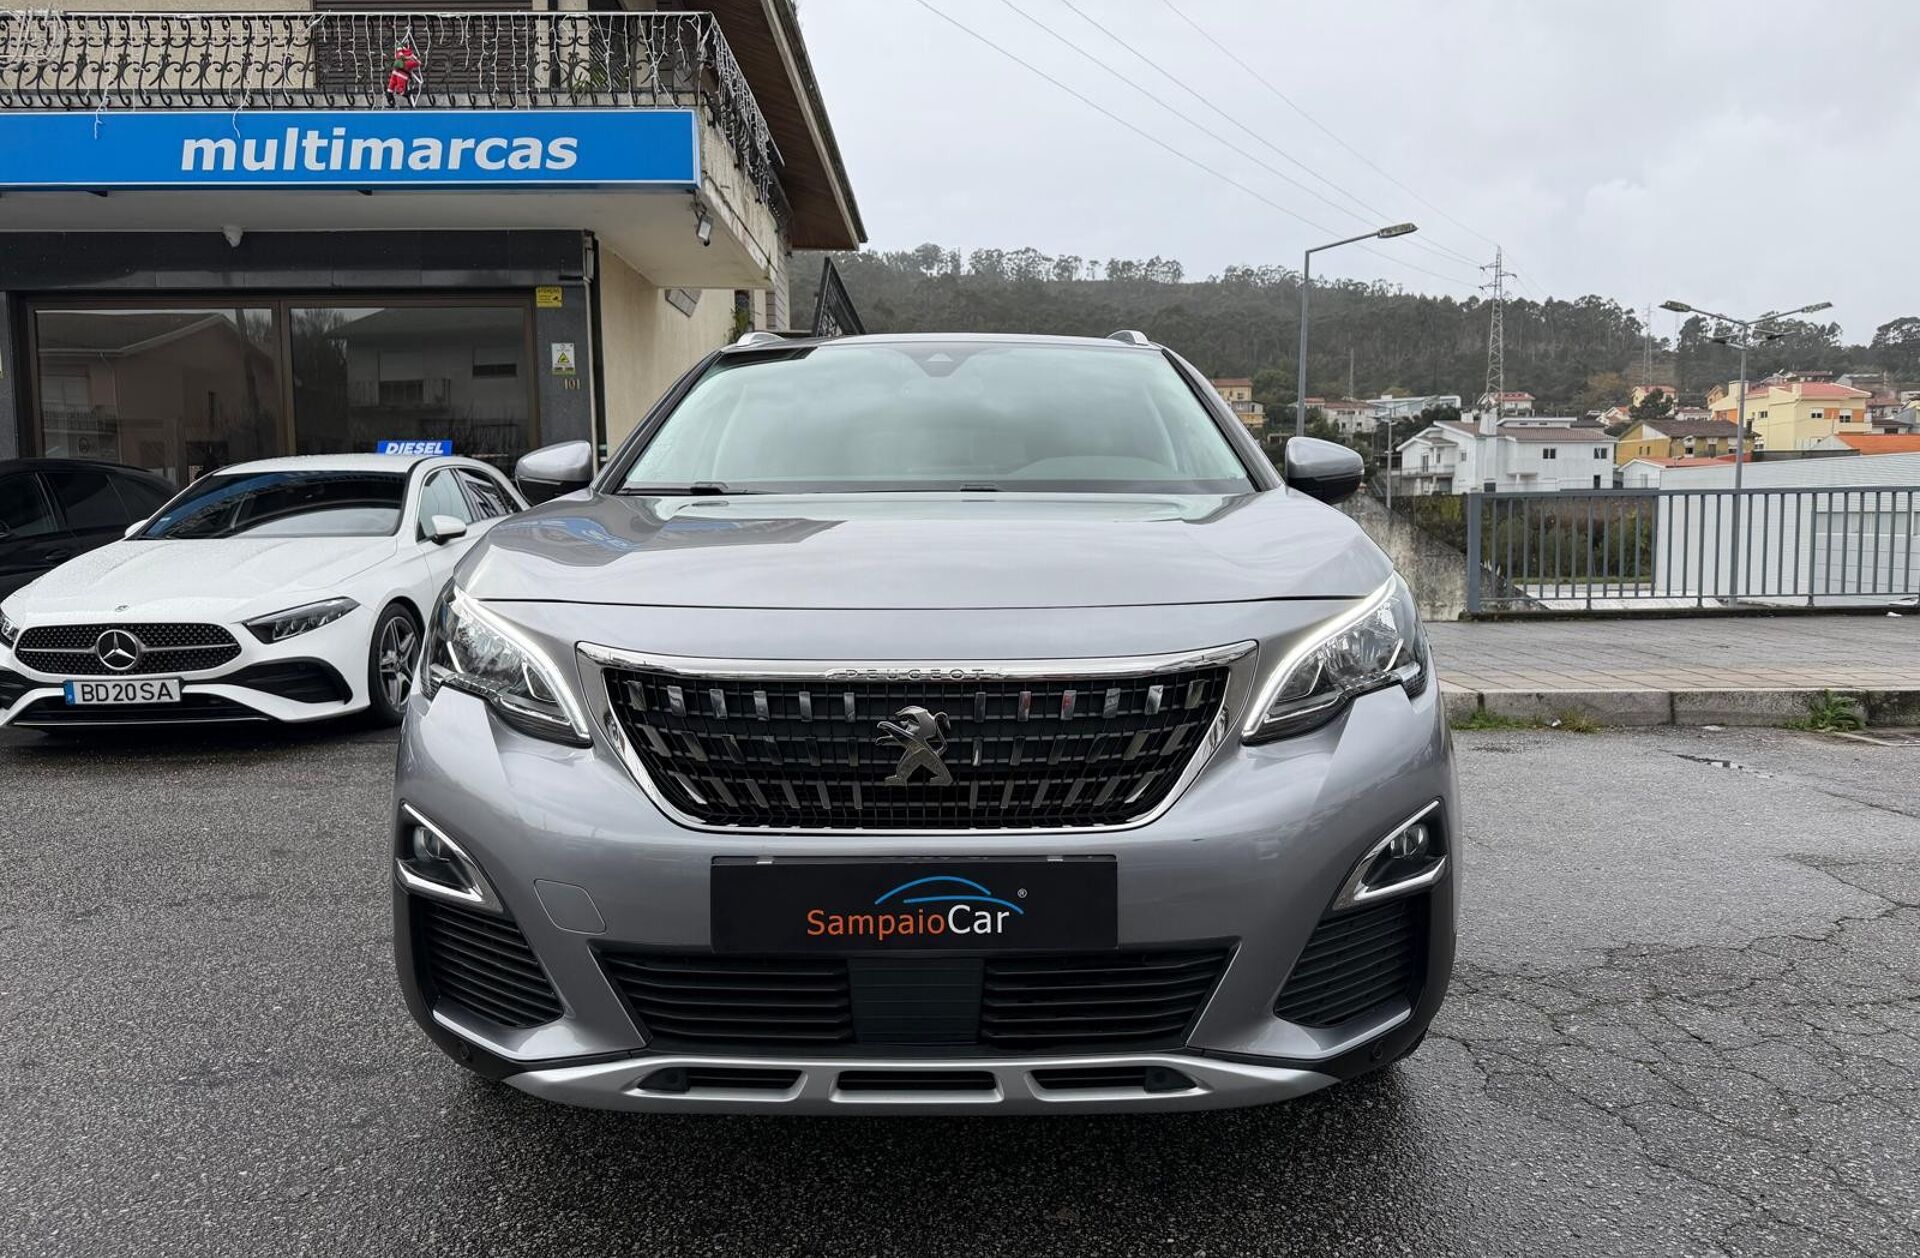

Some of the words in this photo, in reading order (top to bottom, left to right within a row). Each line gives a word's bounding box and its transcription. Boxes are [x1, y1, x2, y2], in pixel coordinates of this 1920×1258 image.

[181, 127, 578, 171] multimarcas
[384, 442, 444, 456] DIESEL
[845, 669, 985, 680] PEUGEOT
[806, 904, 1010, 941] SampaioCar
